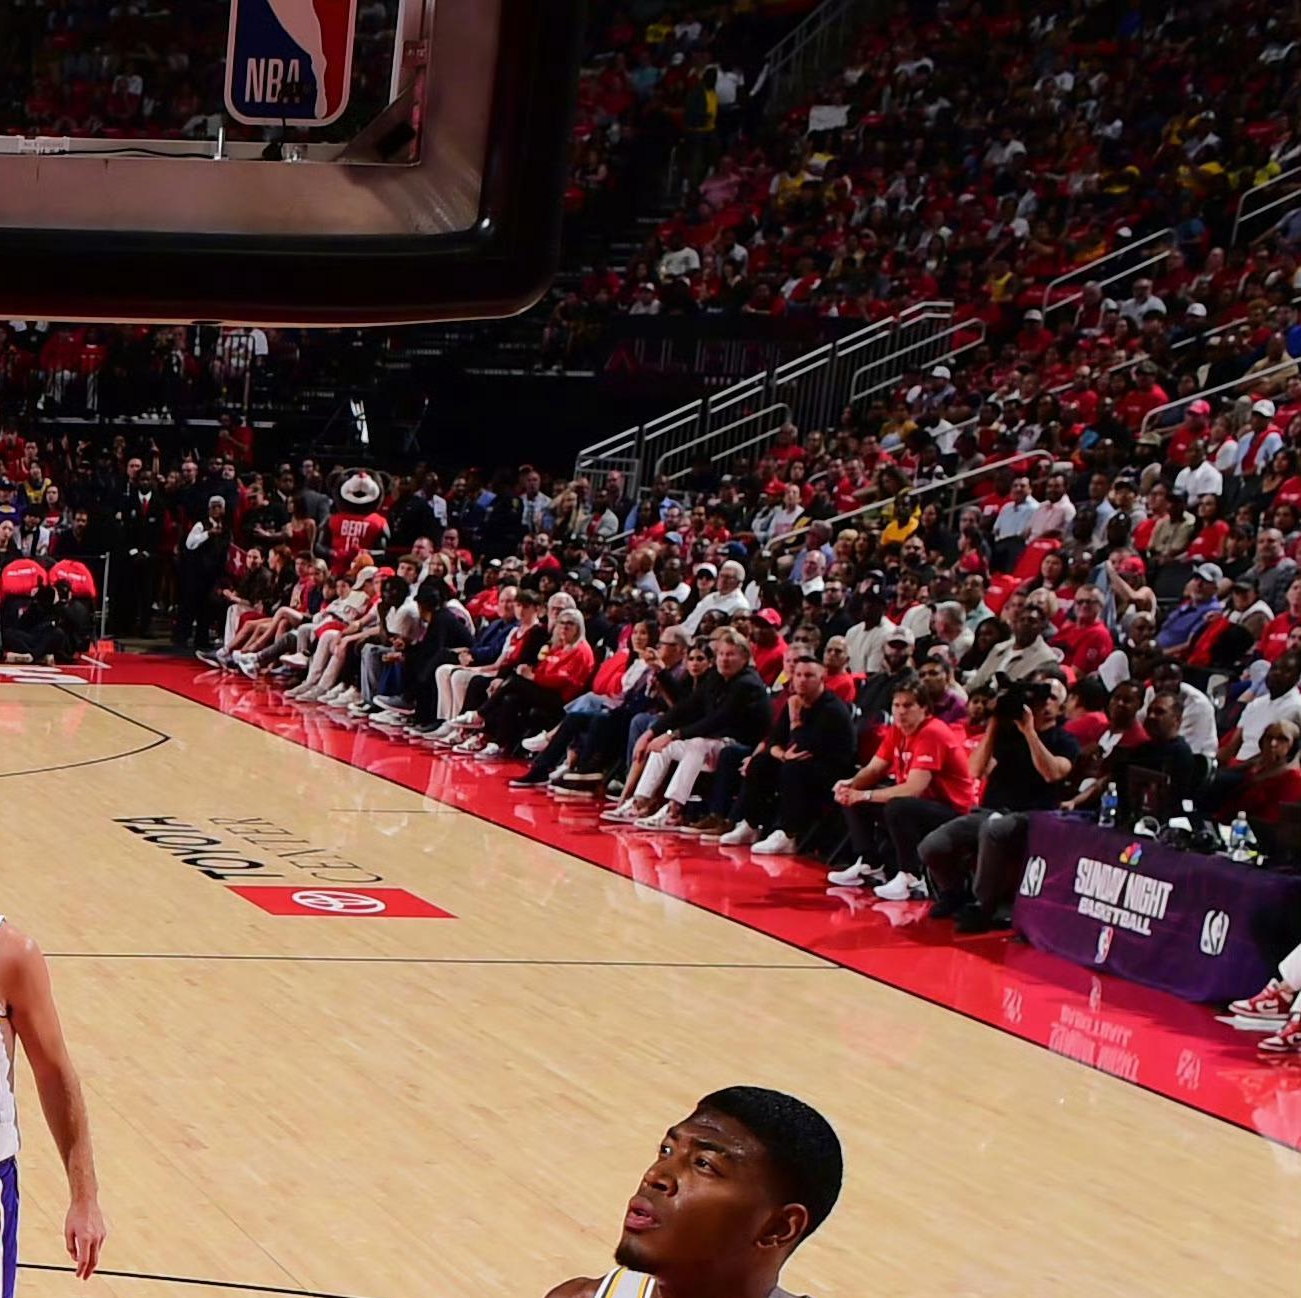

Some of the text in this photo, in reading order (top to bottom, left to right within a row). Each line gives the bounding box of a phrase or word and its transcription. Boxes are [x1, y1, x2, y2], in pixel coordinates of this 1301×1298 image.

[245, 57, 301, 104] NBA
[111, 816, 286, 880] TOYOTA
[1074, 857, 1174, 921] SUNDAY NIGHT
[1077, 897, 1152, 936] BASKETBALL
